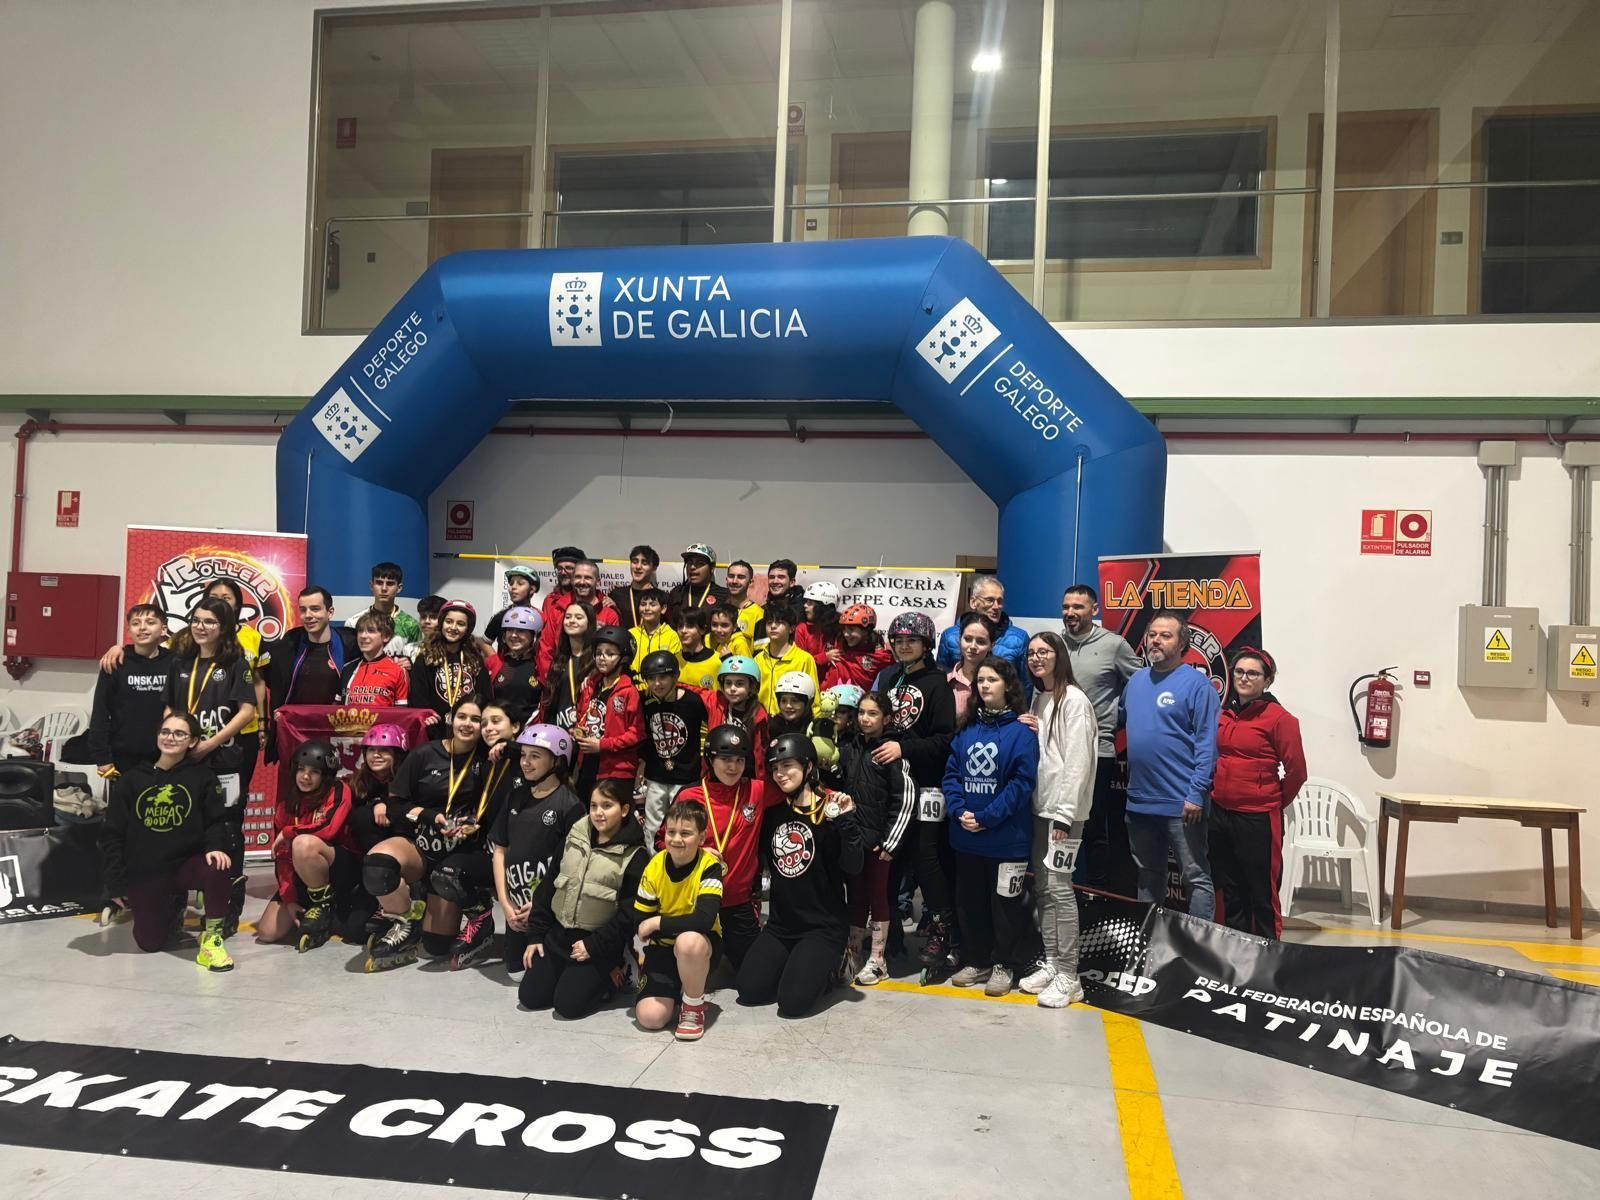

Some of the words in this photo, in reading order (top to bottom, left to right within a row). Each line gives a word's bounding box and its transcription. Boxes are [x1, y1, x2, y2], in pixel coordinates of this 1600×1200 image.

[613, 275, 732, 303] XUNTA
[613, 309, 655, 340] DE
[667, 308, 809, 340] GALICIA
[363, 310, 423, 379] DEPORTE
[373, 330, 429, 391] GALEGO
[994, 376, 1060, 441] GALEGO
[1008, 360, 1085, 434] DEPORTE
[842, 594, 884, 606] PEPE
[888, 595, 948, 608] CASAS
[1105, 581, 1143, 609] LA
[1148, 579, 1252, 609] TIENDA
[352, 687, 391, 698] ROLLERS
[355, 695, 376, 704] LINE
[964, 781, 998, 794] UNITY
[922, 800, 941, 819] 49
[1053, 850, 1074, 870] 64
[1194, 975, 1240, 999] REAL
[1241, 988, 1357, 1021] FEDERACIÓN
[1358, 1006, 1471, 1045] ESPAÑOLA
[1475, 1030, 1508, 1052] DE
[1181, 987, 1520, 1088] PATINAJE
[349, 1097, 786, 1170] CROSS
